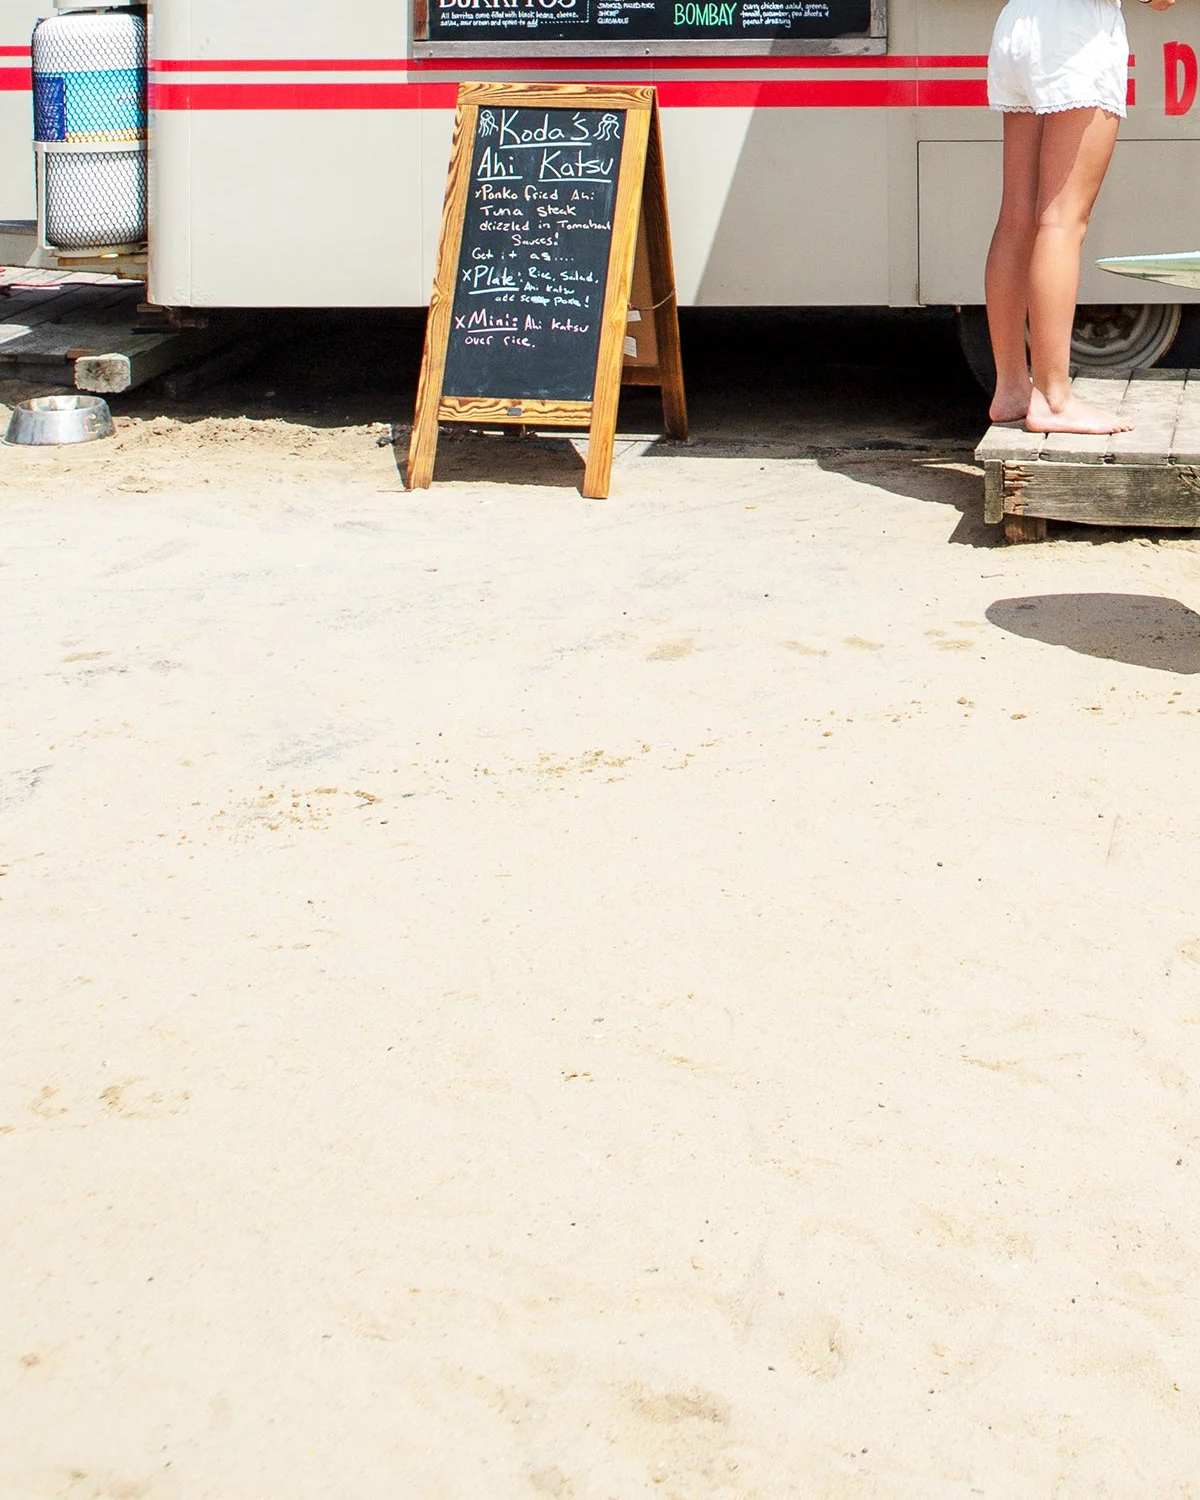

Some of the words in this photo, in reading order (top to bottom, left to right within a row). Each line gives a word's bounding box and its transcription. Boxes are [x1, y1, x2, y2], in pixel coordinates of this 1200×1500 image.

[673, 2, 738, 26] BOMBAY
[477, 146, 514, 178] Ahi
[539, 148, 614, 179] Katsu
[480, 204, 524, 217] Tuna
[479, 220, 530, 232] drizzled
[538, 220, 551, 229] in
[471, 247, 494, 260] Get
[501, 250, 517, 260] it
[467, 308, 519, 328] Mini:
[524, 314, 543, 331] Ahi
[465, 335, 494, 346] over
